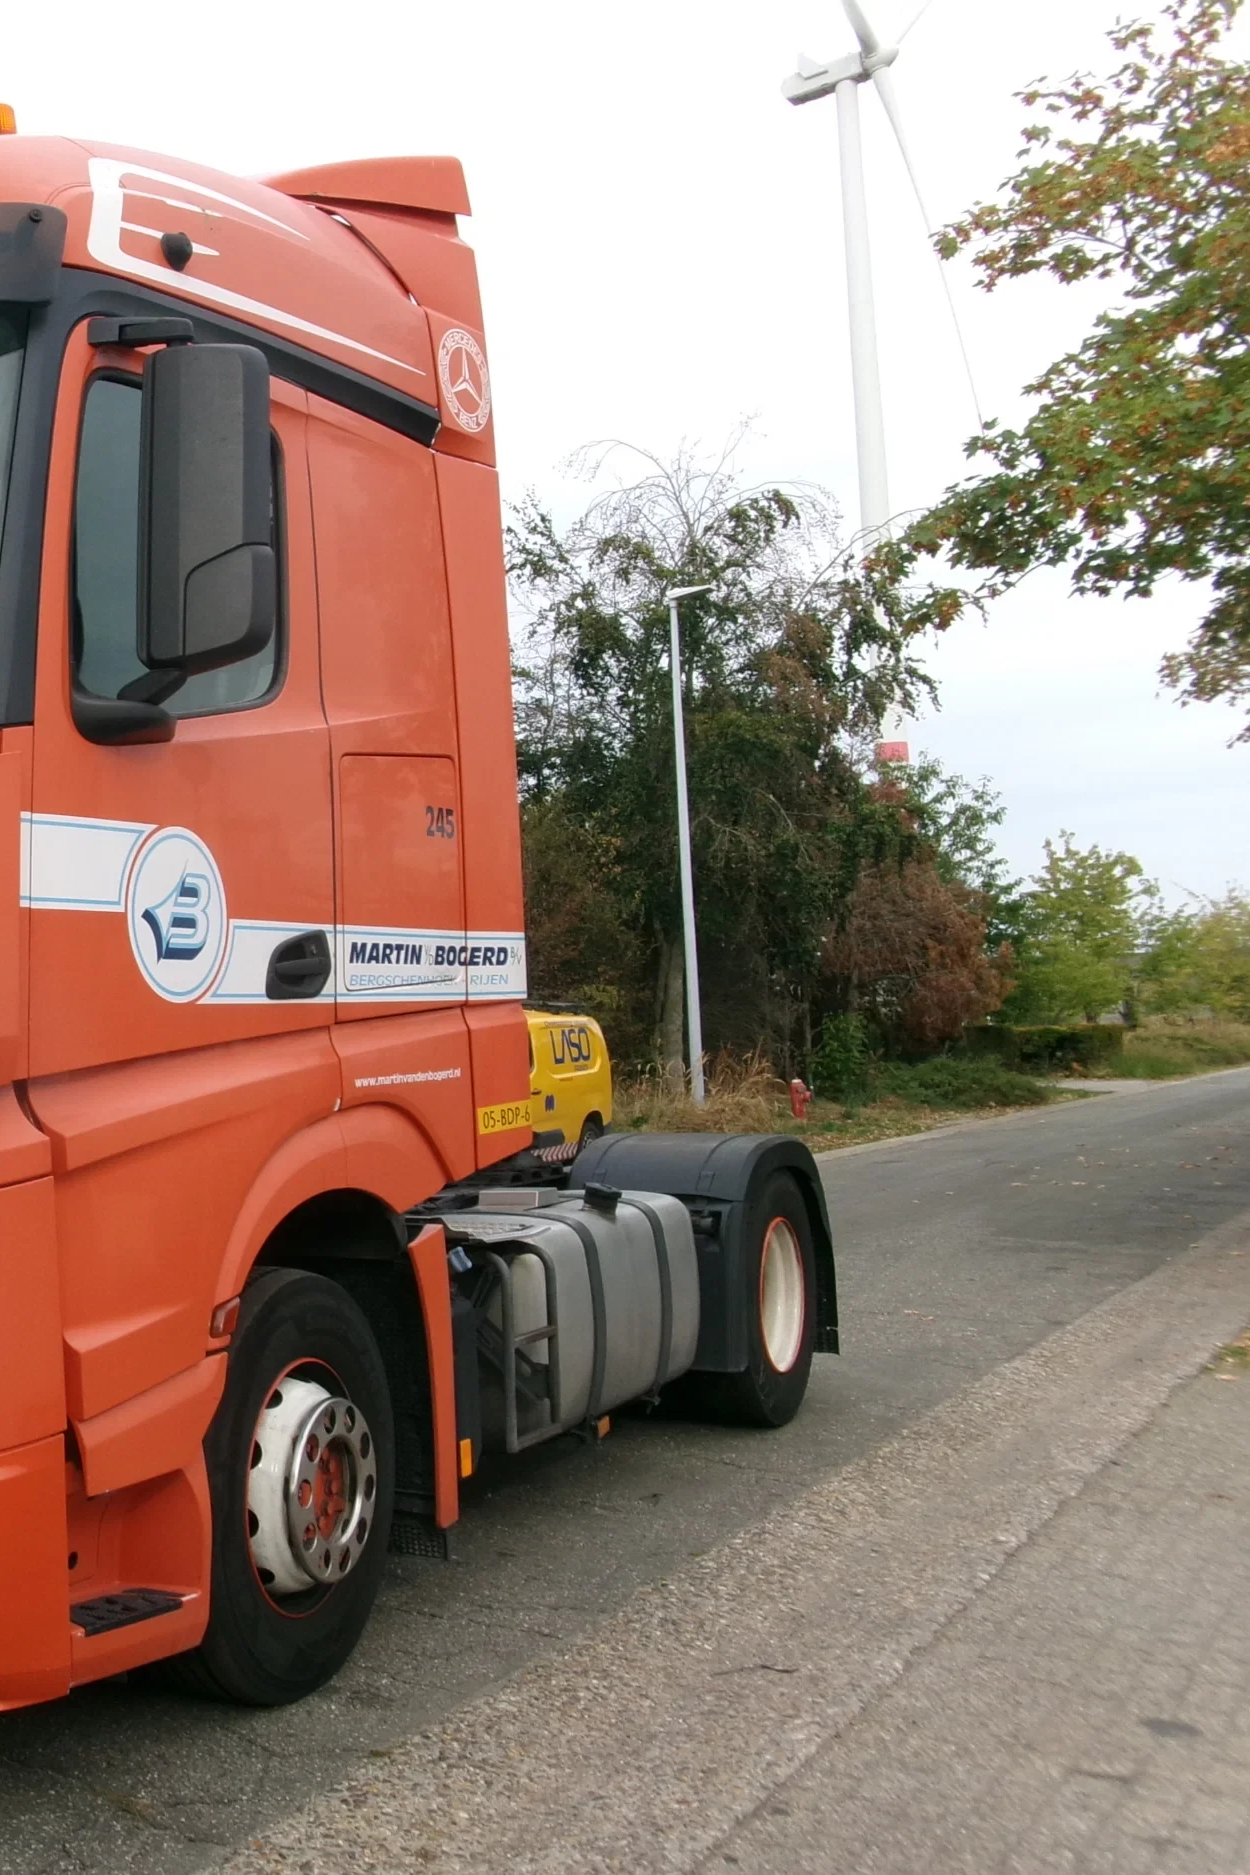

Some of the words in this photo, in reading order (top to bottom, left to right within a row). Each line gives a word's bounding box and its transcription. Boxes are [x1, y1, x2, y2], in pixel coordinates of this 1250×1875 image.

[426, 805, 455, 839] 245
[349, 941, 423, 965] MARTIN
[434, 945, 509, 967] BOGERD
[470, 974, 509, 986] RIJEN
[550, 1026, 591, 1065] LASO
[354, 1068, 461, 1088] www.martinvandenbogerd.nl
[483, 1105, 531, 1129] 05-BDP-6
